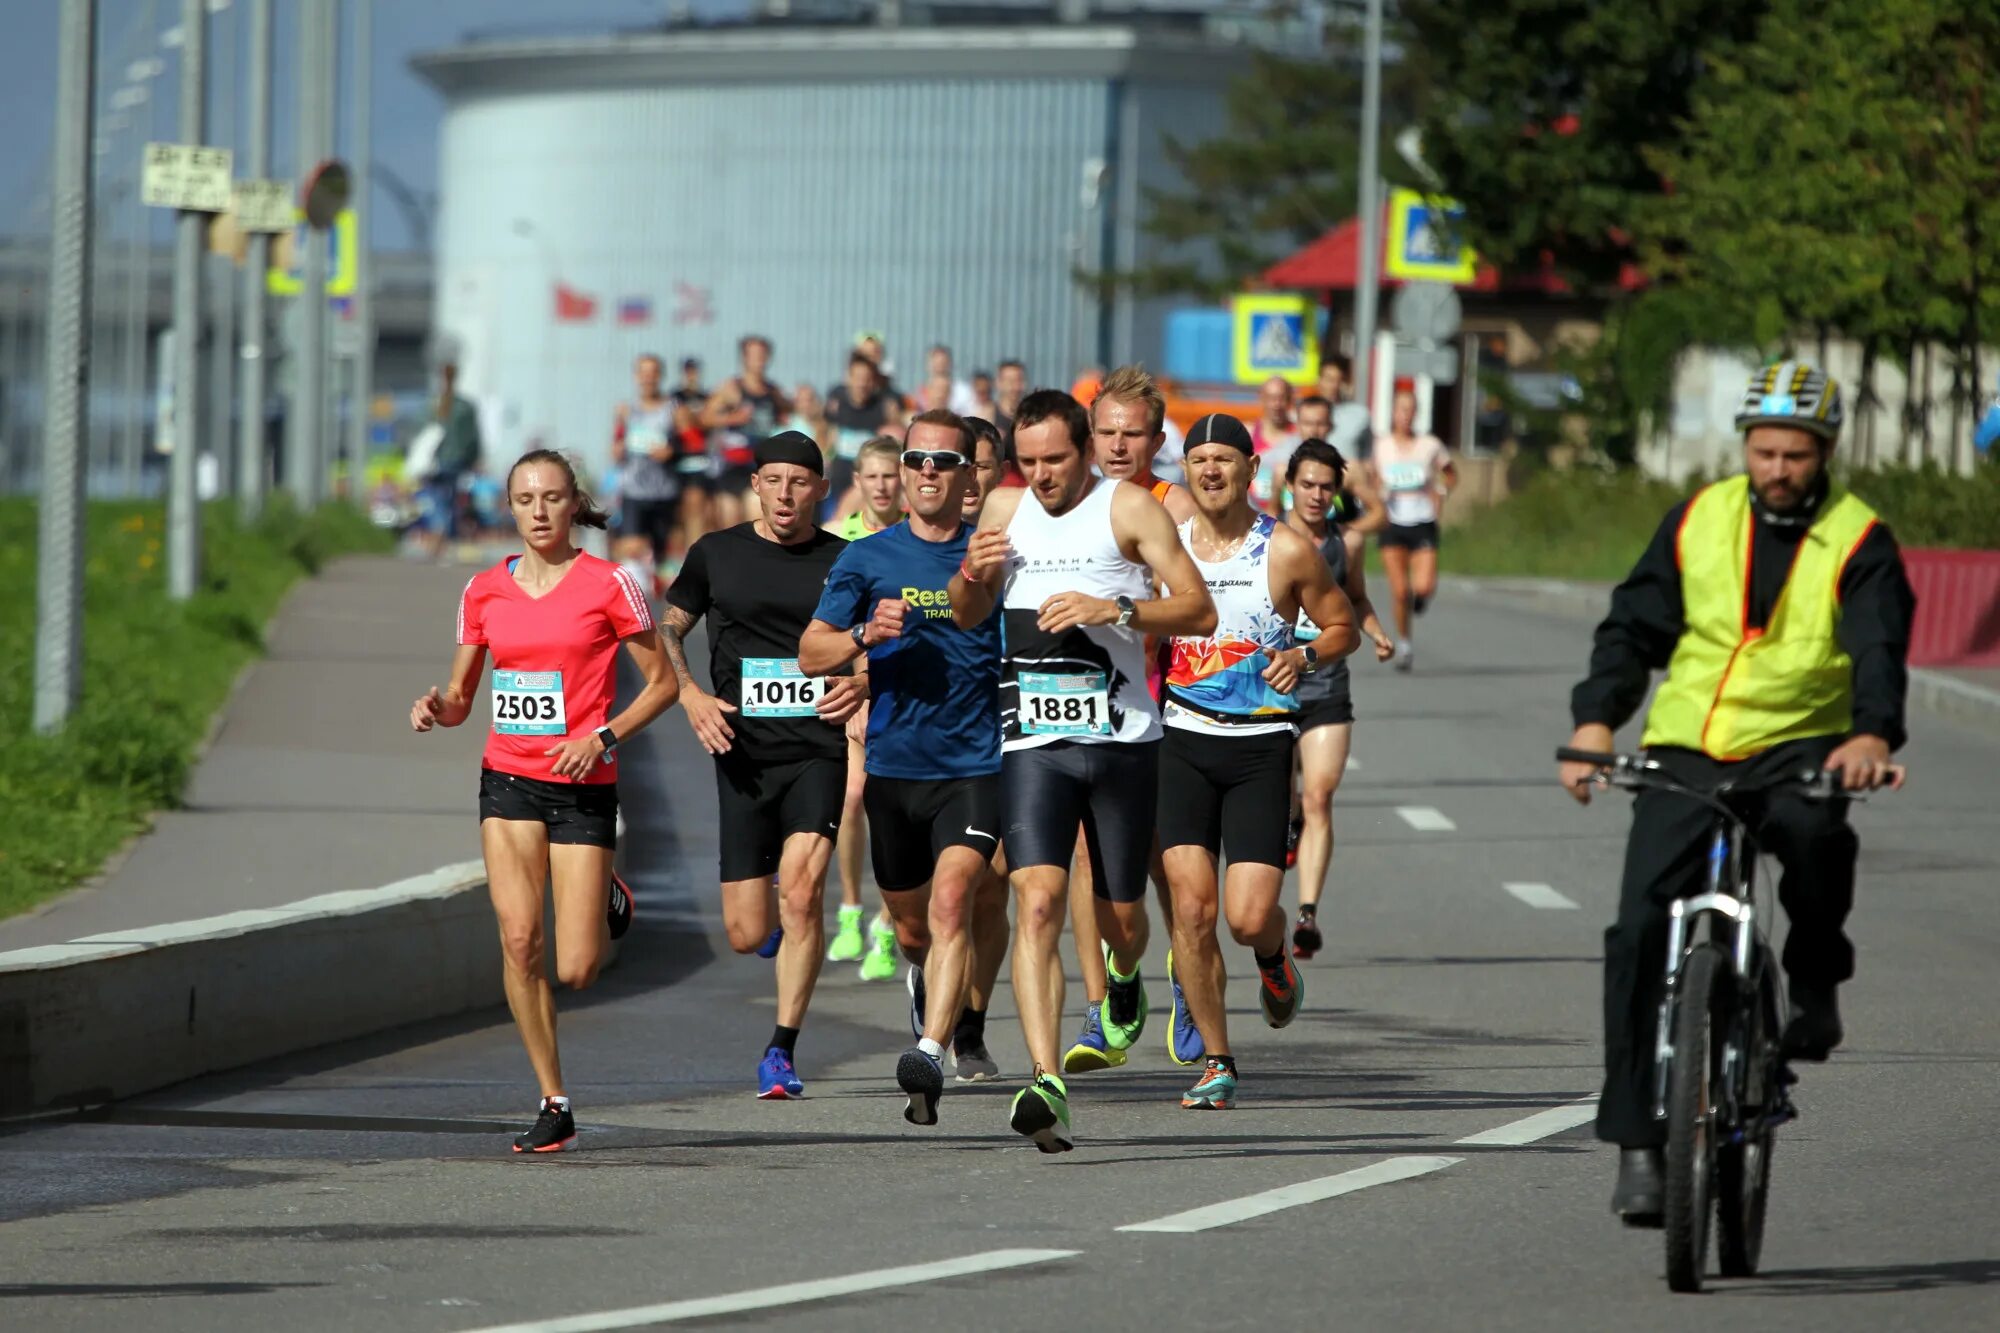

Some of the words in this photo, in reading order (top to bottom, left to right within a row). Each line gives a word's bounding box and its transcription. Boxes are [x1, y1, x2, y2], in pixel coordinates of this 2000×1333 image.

[752, 681, 815, 704] 1016
[497, 694, 557, 720] 2503
[1030, 697, 1096, 721] 1881
